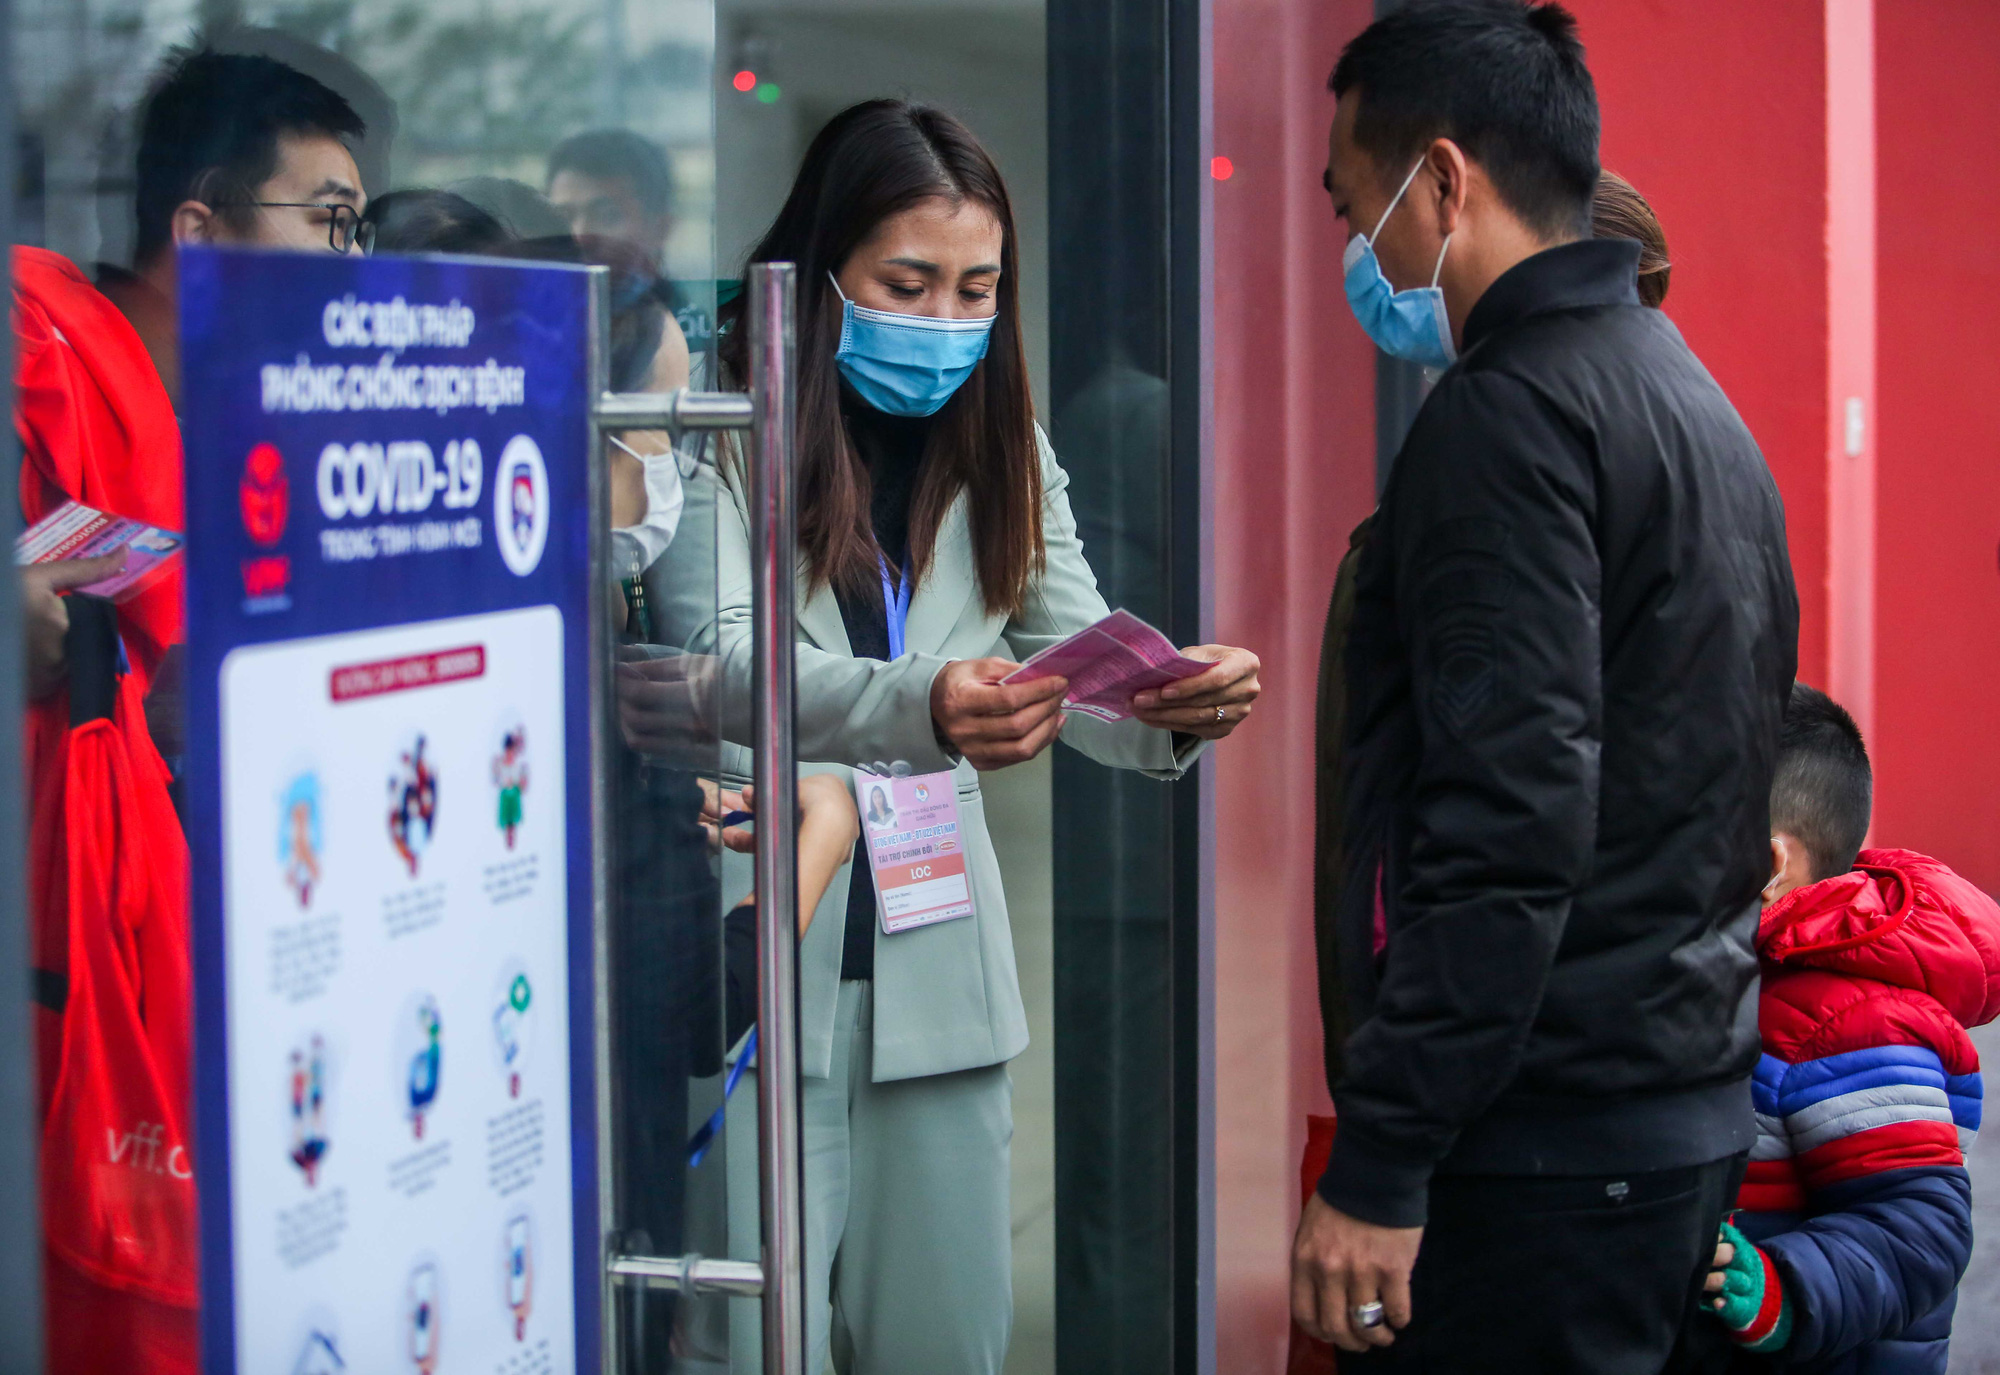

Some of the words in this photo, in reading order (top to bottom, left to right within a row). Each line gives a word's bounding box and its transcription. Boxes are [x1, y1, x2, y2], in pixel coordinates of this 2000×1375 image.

[316, 438, 483, 520] COVID-19
[899, 831, 911, 843] NAM
[944, 822, 956, 834] NAM
[911, 865, 931, 880] LOC
